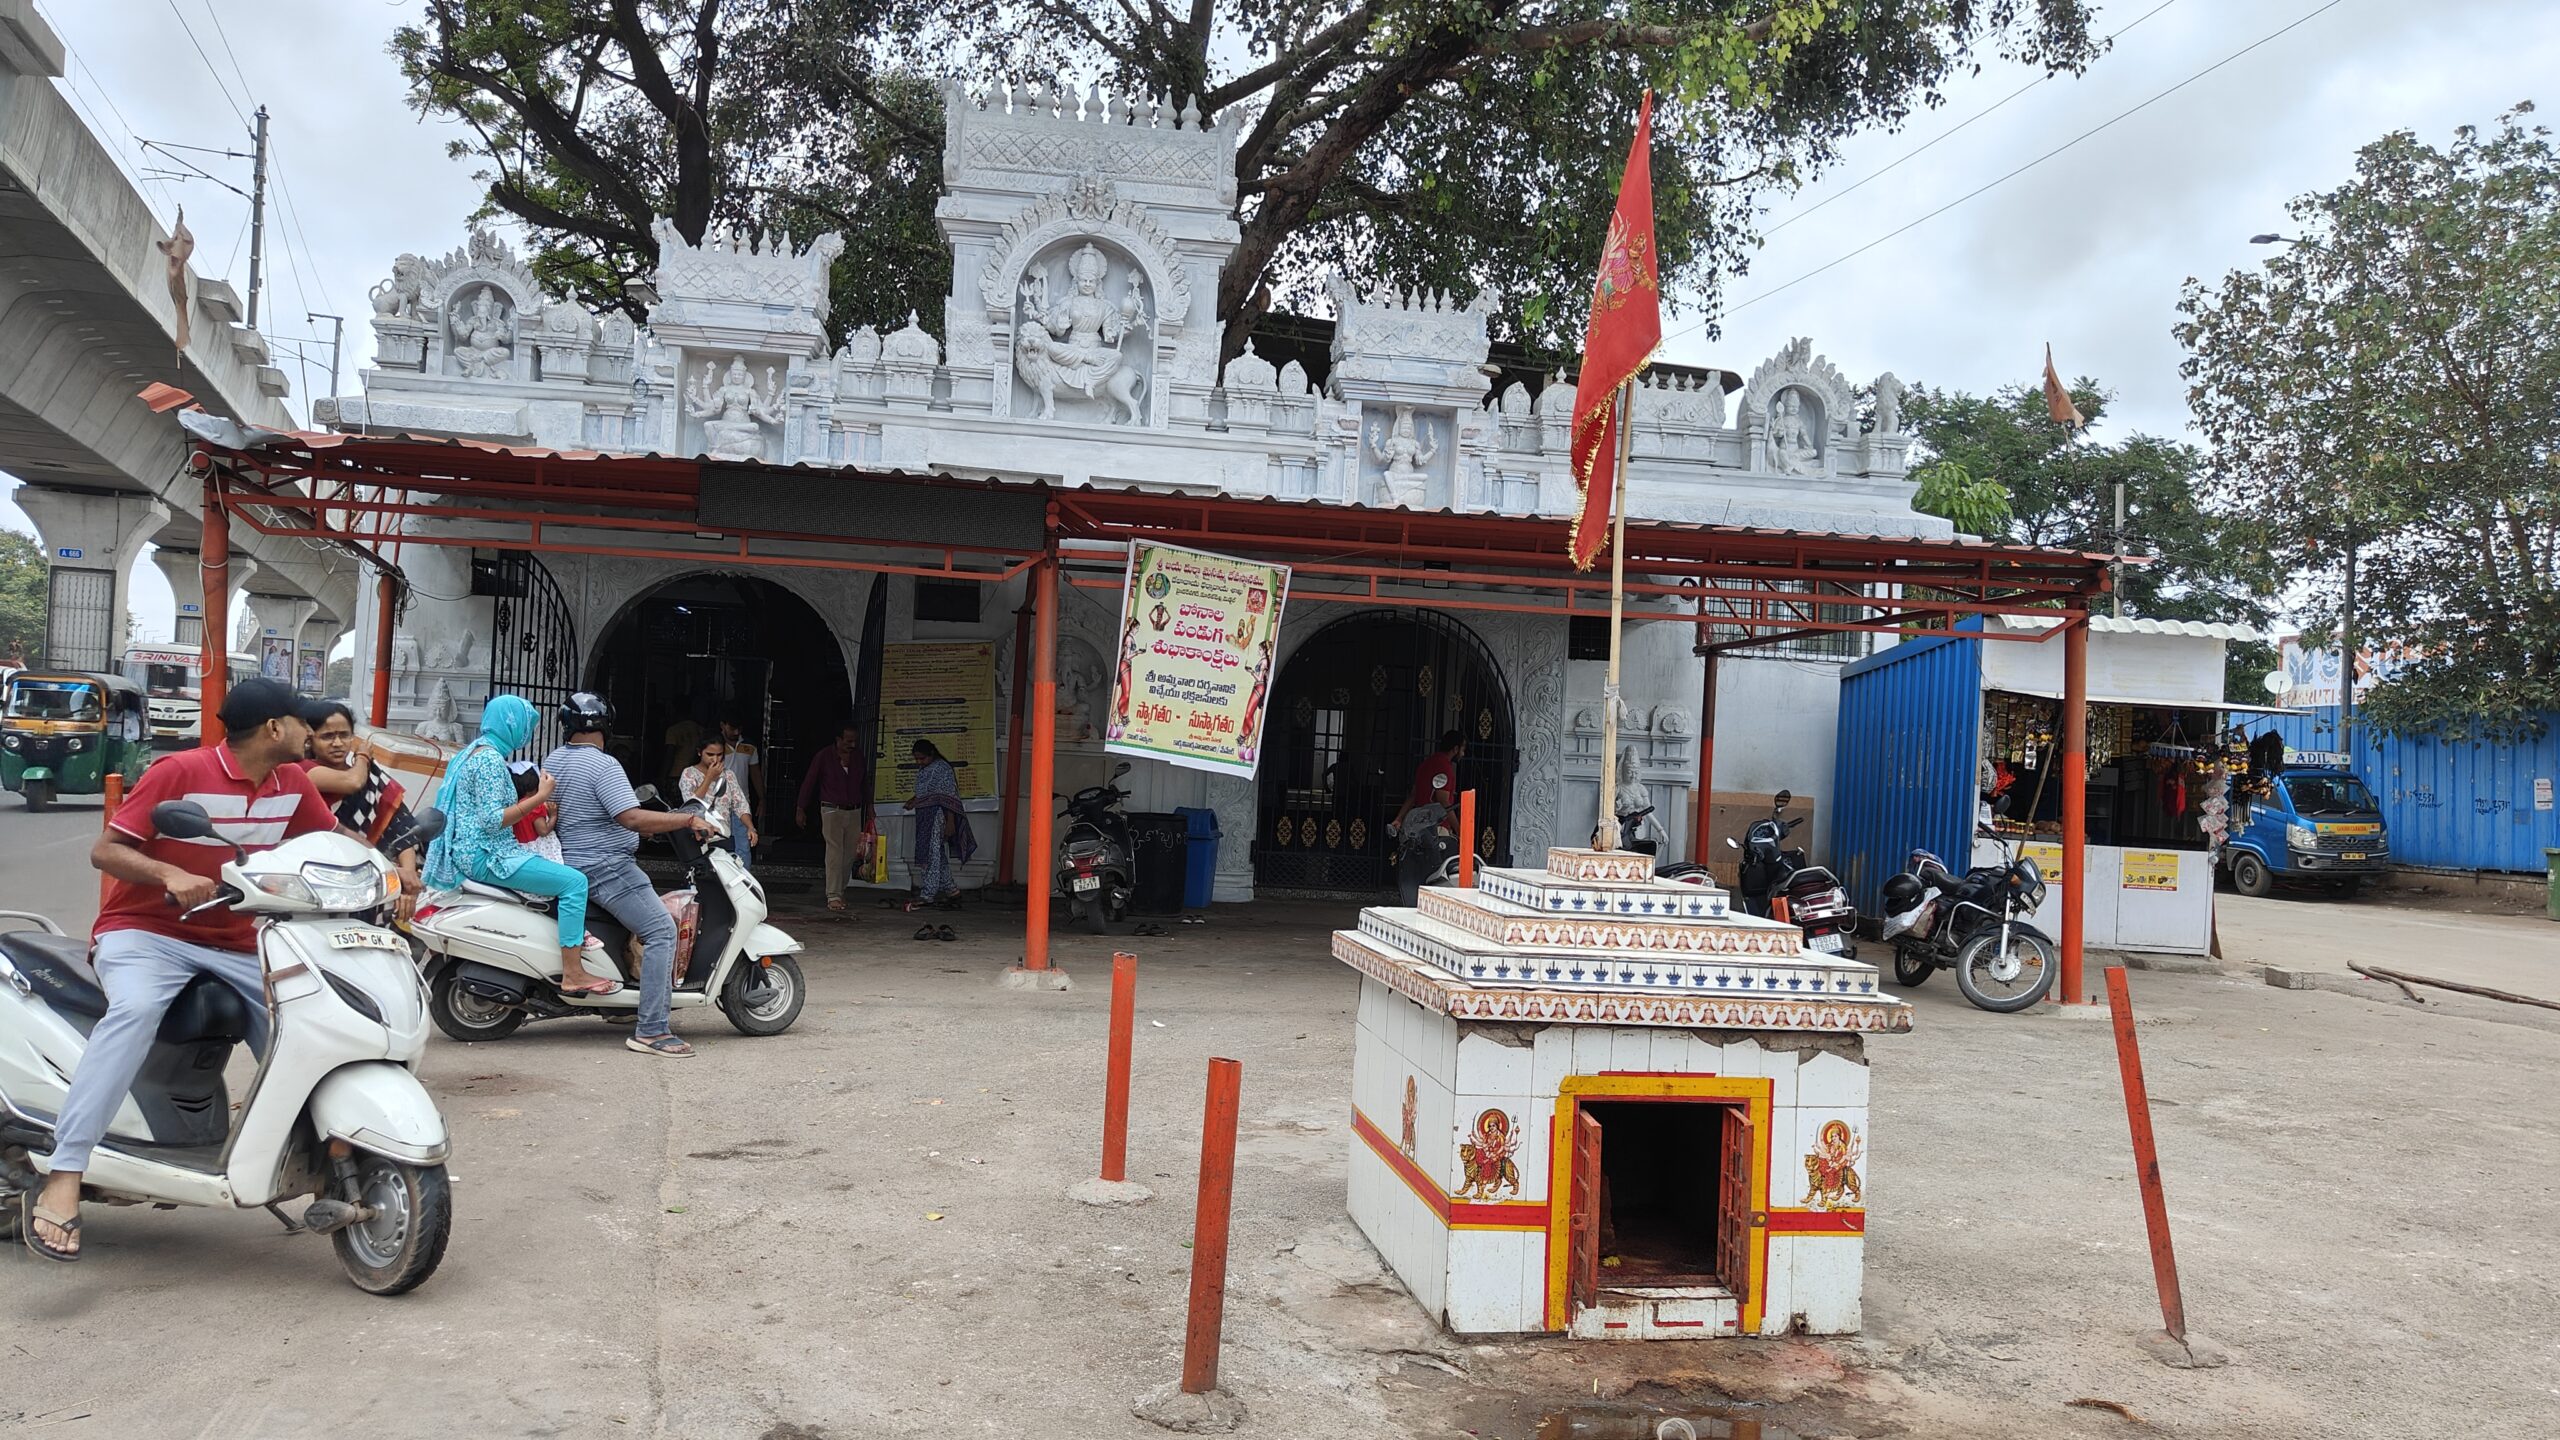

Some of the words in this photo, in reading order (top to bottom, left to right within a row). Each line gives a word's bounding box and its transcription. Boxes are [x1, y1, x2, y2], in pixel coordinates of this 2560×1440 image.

[1179, 603, 1225, 622] బోనాల
[1173, 620, 1224, 644] పండుగ
[1151, 639, 1240, 672] శుభాకాంక్షలు
[1145, 670, 1156, 683] శ్రీ
[1196, 679, 1237, 695] దర్శనానికి
[1149, 685, 1180, 699] విచ్చేయు
[1181, 691, 1228, 706] భక్తజనులకు
[1136, 701, 1172, 726] స్వాగతం
[1188, 710, 1235, 736] సుస్వాగతం
[2296, 753, 2330, 764] ADIL
